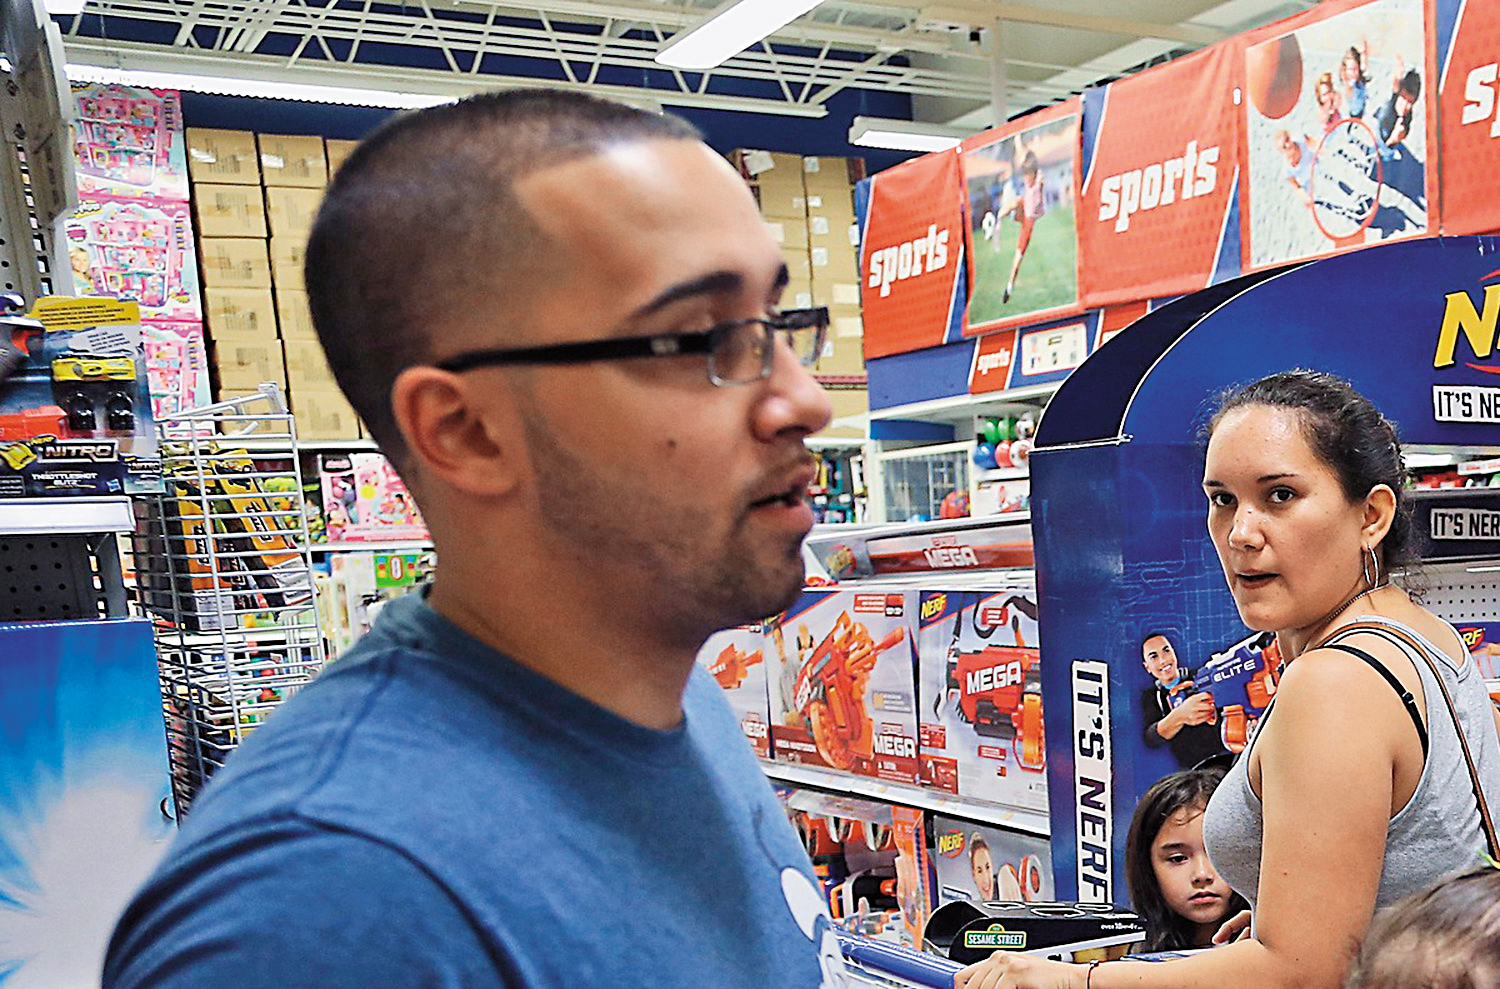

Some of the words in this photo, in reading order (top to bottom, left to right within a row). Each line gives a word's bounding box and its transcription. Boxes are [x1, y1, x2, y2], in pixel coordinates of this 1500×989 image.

[1099, 140, 1221, 233] sports
[868, 224, 949, 297] sports
[977, 345, 1010, 375] sports
[1436, 389, 1473, 420] IT'S
[44, 443, 112, 458] NITRO
[1434, 512, 1463, 537] IT'S
[923, 546, 979, 568] MEGA
[921, 594, 948, 620] NERF
[966, 660, 1022, 695] MEGA
[1213, 659, 1257, 683] ELITE
[1076, 666, 1105, 761] IT'S
[874, 734, 917, 758] MEGA
[938, 833, 965, 855] NERF
[1079, 777, 1108, 903] NERF
[968, 934, 995, 946] SESAME
[997, 934, 1023, 946] STREET
